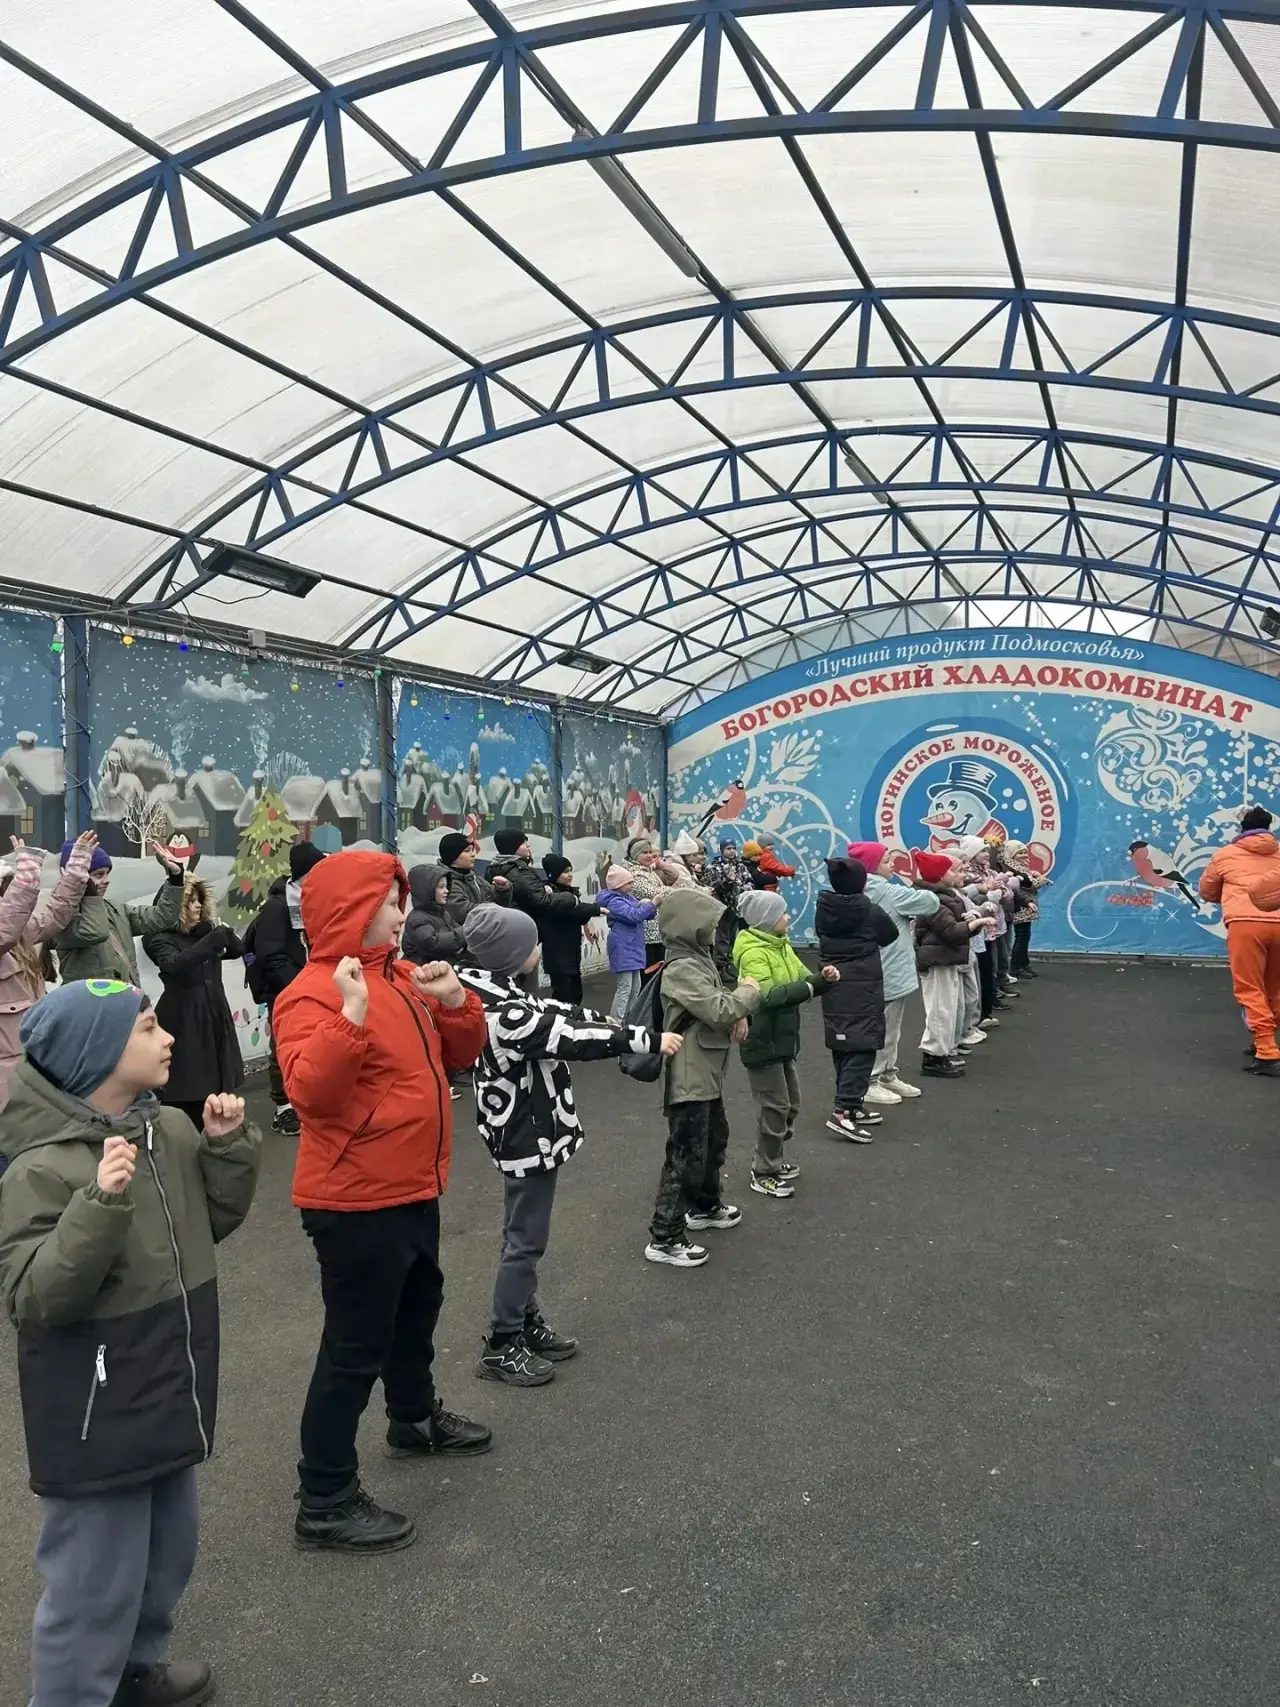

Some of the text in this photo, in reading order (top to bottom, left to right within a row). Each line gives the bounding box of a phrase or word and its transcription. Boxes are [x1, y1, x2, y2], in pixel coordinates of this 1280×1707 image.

[805, 634, 1146, 677] «Лучший продукт Подмосковья»
[720, 663, 1254, 740] БОГОРОДСКИЙ ХЛАДОКОМБИНАТ
[881, 736, 1055, 839] НОГИНСКОЕ МОРОЖЕНОЕ
